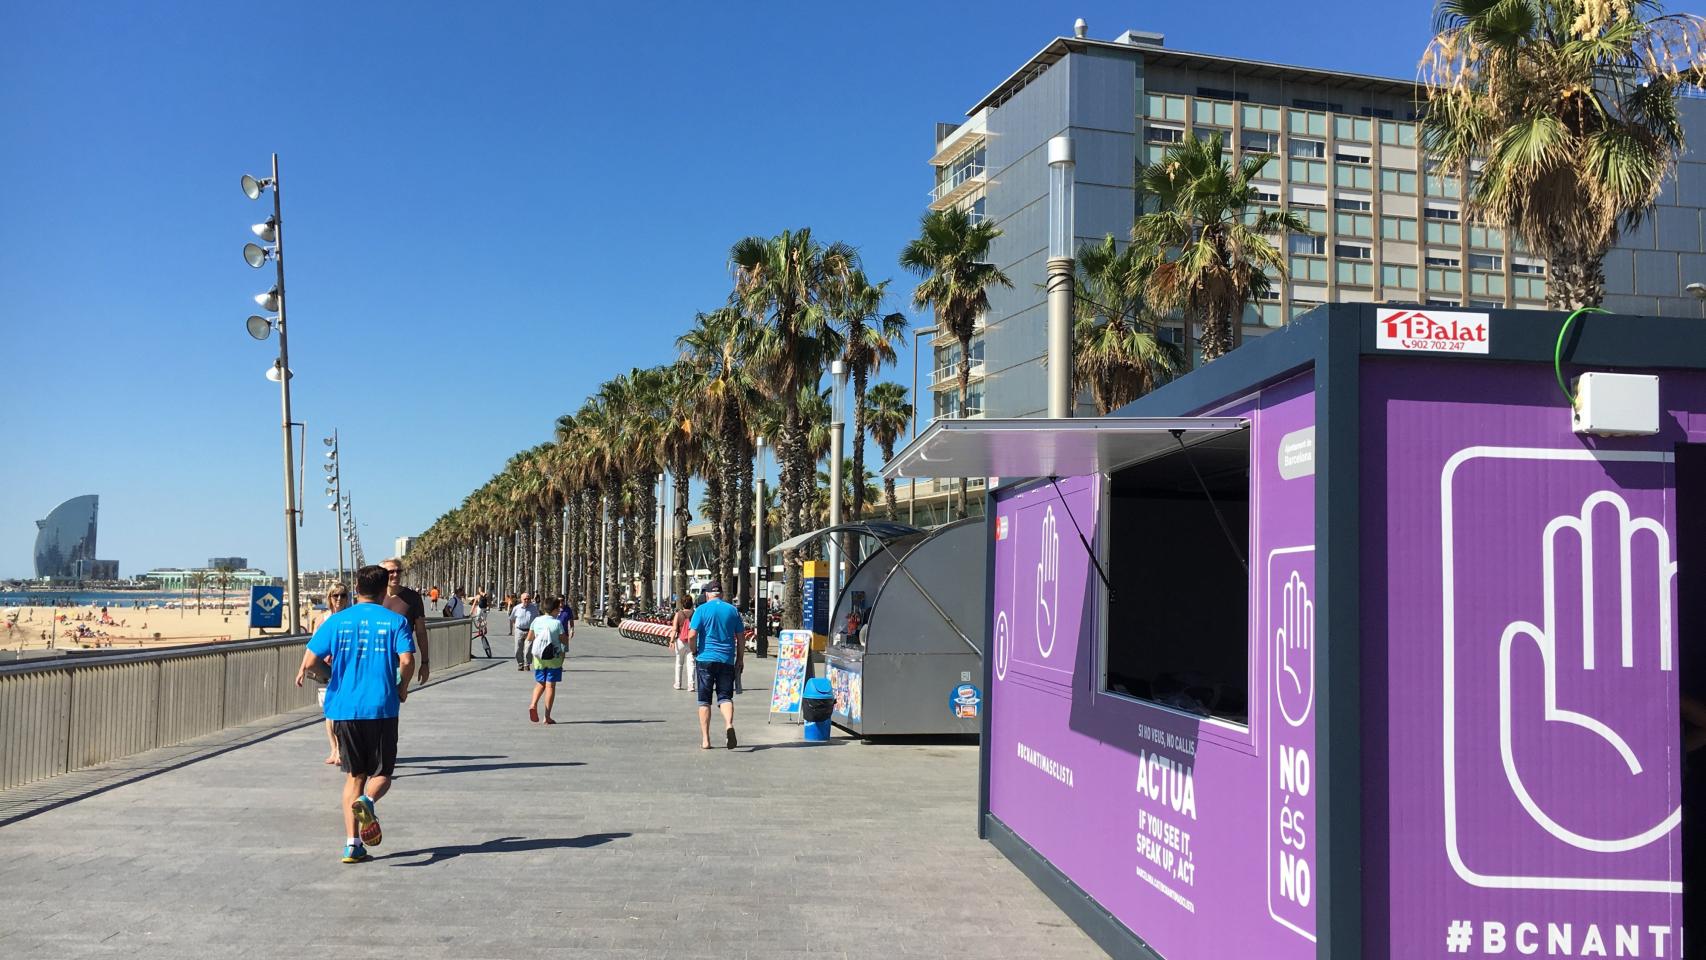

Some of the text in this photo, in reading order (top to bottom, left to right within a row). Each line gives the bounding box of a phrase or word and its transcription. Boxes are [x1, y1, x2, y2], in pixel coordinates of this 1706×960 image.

[1410, 316, 1487, 342] Balat
[1411, 341, 1465, 351] 902 702 247
[1284, 451, 1312, 467] Barcelona
[262, 599, 274, 607] W
[1138, 723, 1144, 737] SI
[1144, 726, 1151, 740] HO
[1151, 728, 1166, 748] VEUS,
[1166, 733, 1175, 748] NO
[1136, 748, 1197, 821] ACTUA
[1280, 744, 1310, 797] NO
[1139, 808, 1193, 862] IF YOU SEE IT,
[1280, 794, 1306, 850] és
[1136, 832, 1161, 867] SPEAK
[1177, 857, 1195, 887] ACT
[1280, 850, 1311, 908] NO
